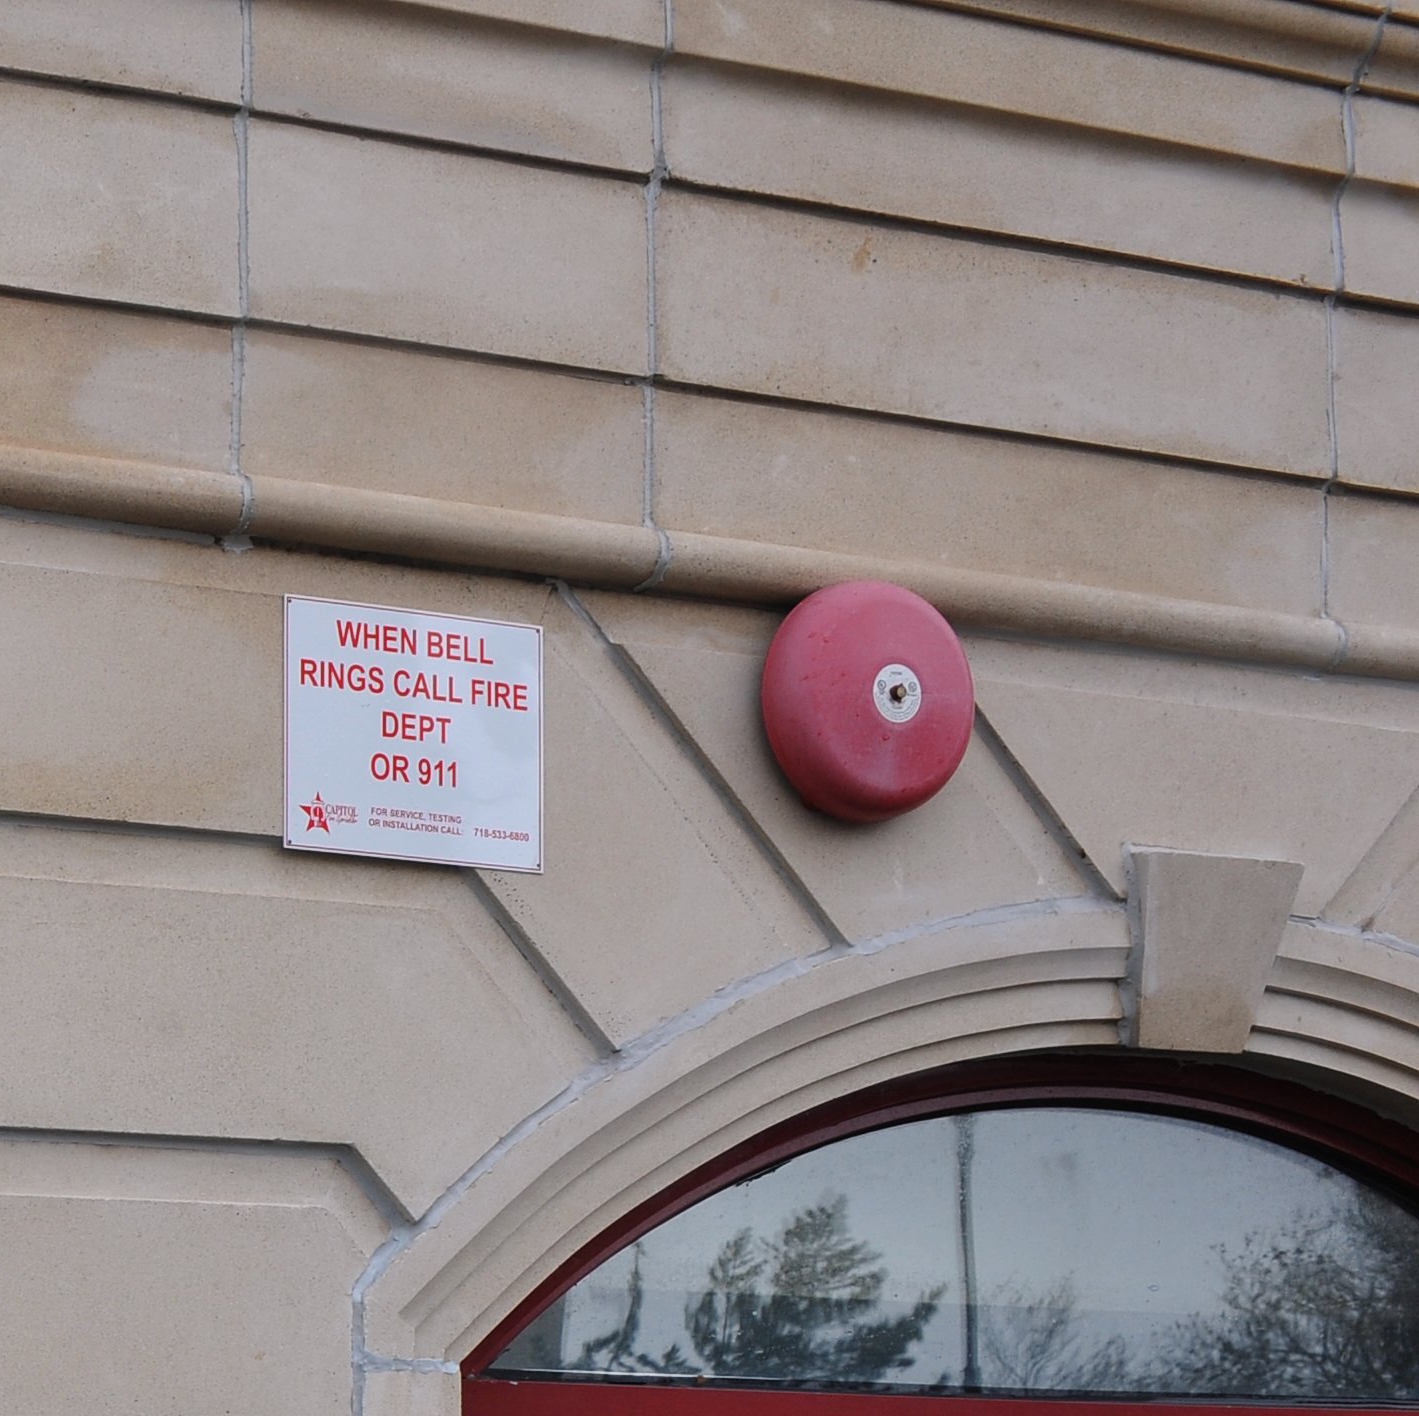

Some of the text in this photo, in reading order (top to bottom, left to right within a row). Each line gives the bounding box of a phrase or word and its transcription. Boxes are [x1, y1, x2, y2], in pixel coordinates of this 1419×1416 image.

[336, 619, 494, 665] WHEN BELL
[299, 658, 529, 712] RINGS CALL FIRE
[381, 710, 452, 745] DEPT
[370, 752, 458, 788] OR 911
[368, 817, 381, 828] OR
[382, 819, 439, 832] INSTALLATION
[370, 807, 388, 817] FOR
[428, 813, 462, 824] TESTING
